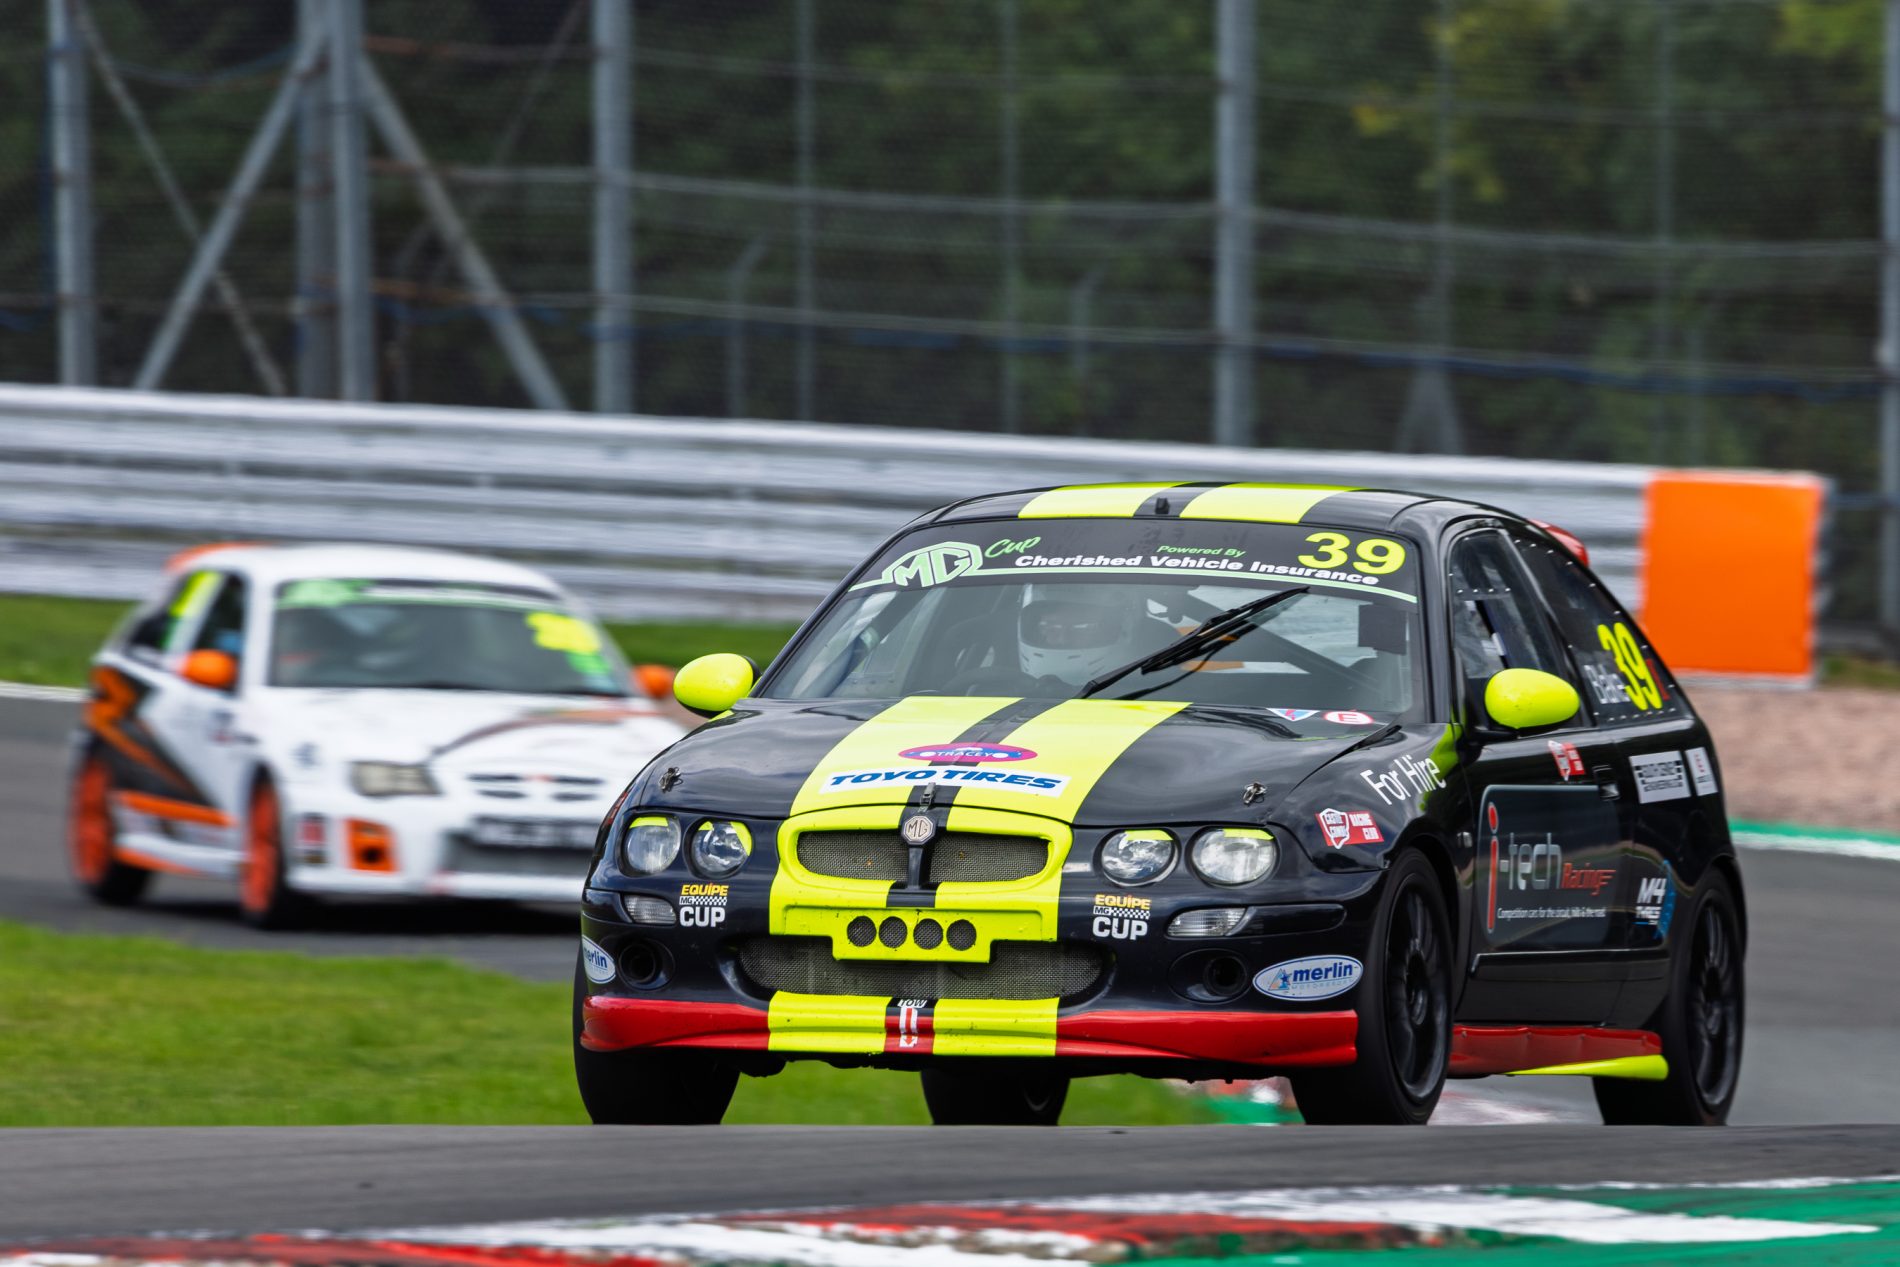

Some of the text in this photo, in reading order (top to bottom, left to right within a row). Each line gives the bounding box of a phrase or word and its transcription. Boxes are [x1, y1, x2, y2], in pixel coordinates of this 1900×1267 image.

[892, 536, 1041, 588] MG Cup
[1157, 545, 1246, 558] Powered By
[1298, 532, 1406, 575] 39
[1015, 555, 1379, 585] Cherished Vehicle Insurance
[1597, 622, 1663, 710] 39
[830, 770, 1062, 789] TOYO TIRES
[1360, 755, 1446, 805] For Hire
[906, 821, 929, 839] MG
[681, 882, 729, 897] EQUIPE
[1562, 862, 1612, 896] Racing
[1636, 877, 1667, 904] M4
[1093, 906, 1110, 916] MG
[1095, 894, 1151, 910] EQUIPE
[679, 906, 726, 927] CUP
[1092, 917, 1148, 940] CUP
[1292, 962, 1353, 982] merlin
[897, 999, 927, 1008] TOW
